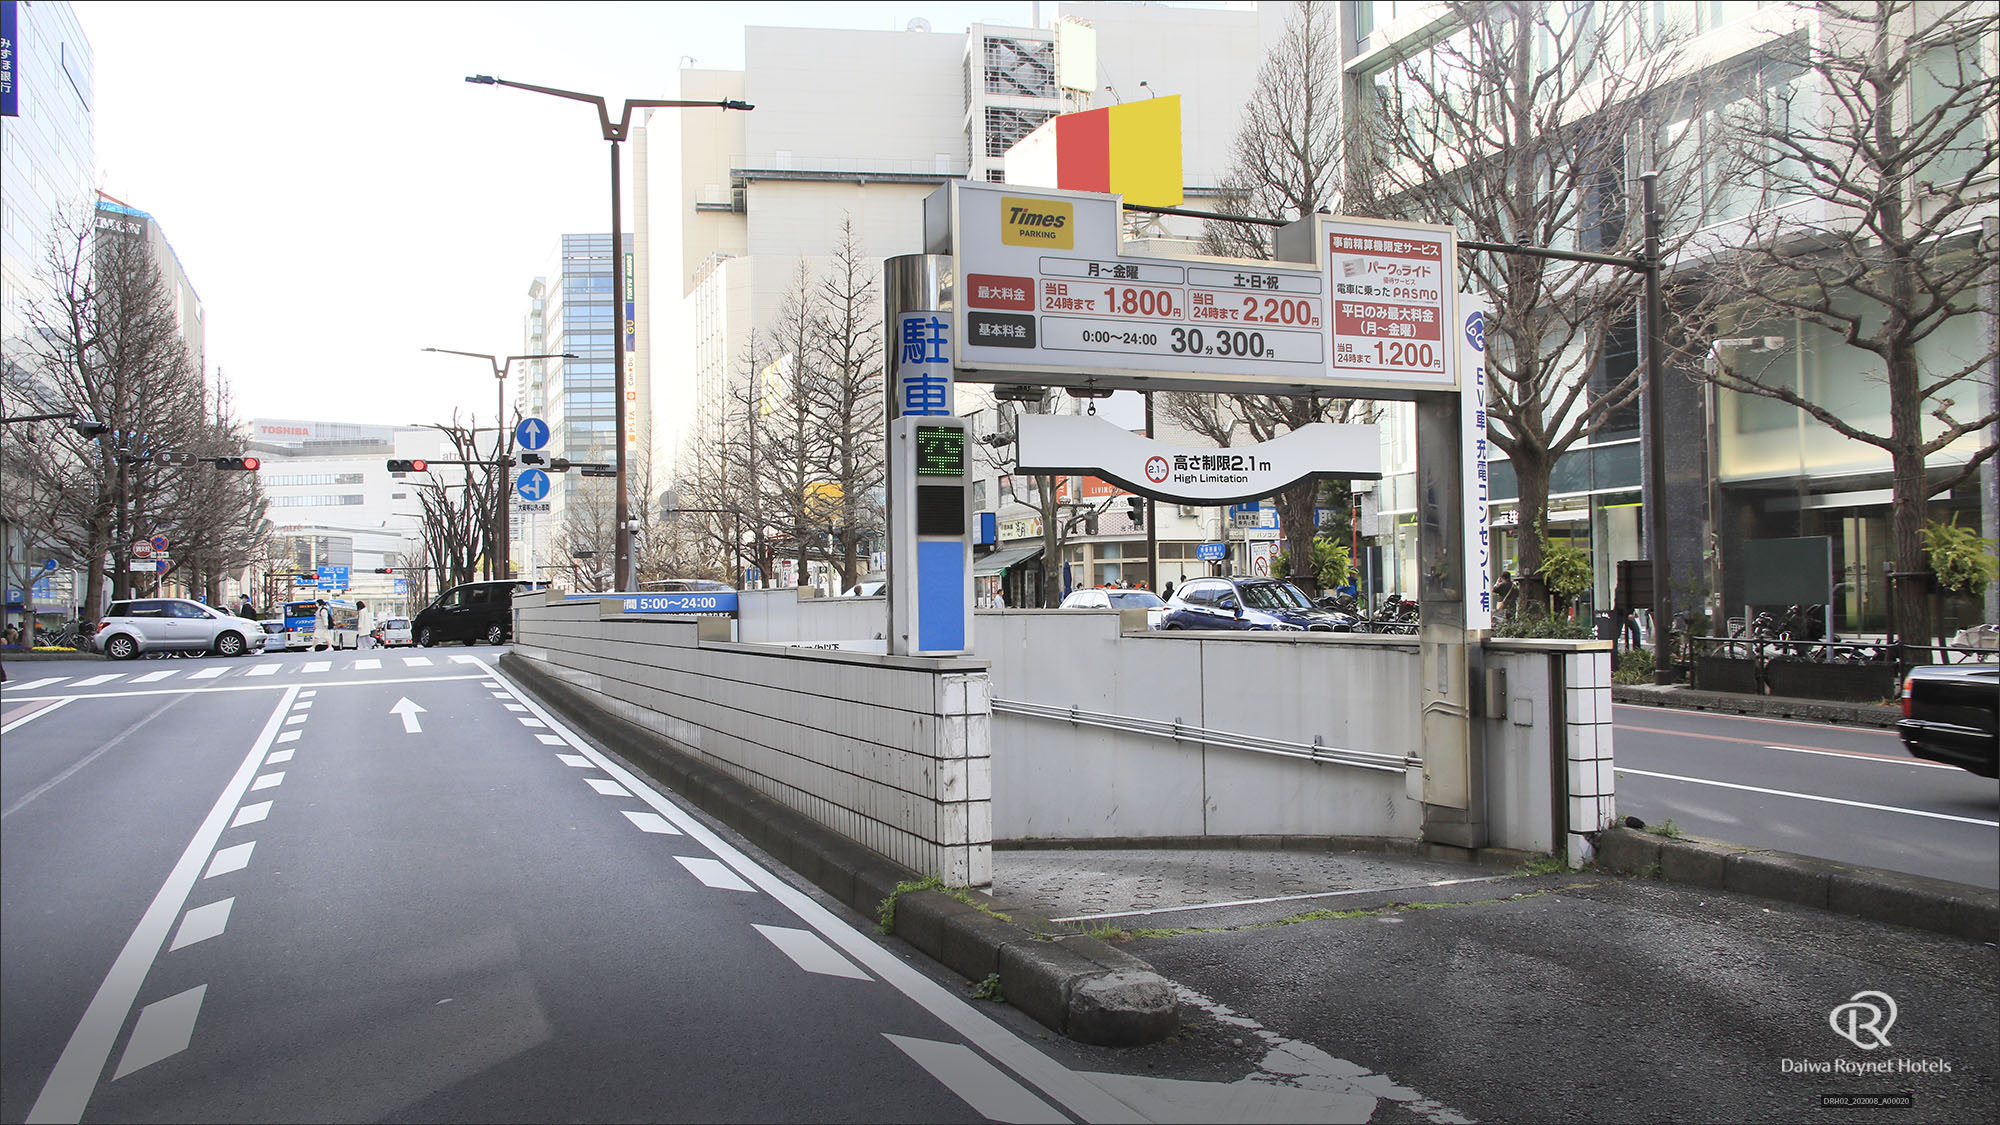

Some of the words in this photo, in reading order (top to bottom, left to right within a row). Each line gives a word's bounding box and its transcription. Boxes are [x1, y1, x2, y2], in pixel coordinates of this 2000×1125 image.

[1009, 206, 1066, 228] Times
[1019, 229, 1057, 239] PARKING
[1332, 236, 1440, 256] 事前精算機限定サービス
[977, 285, 1026, 302] 最大料金
[1045, 282, 1068, 296] 当日
[1336, 282, 1391, 298] 電車に乗った
[1392, 286, 1439, 301] PASMO
[1046, 296, 1096, 312] 24時まで
[1193, 292, 1214, 306] 当日
[1193, 306, 1240, 321] 24時まで
[1341, 303, 1435, 323] 平日のみ最大料金
[626, 319, 635, 335] GU
[978, 322, 1027, 339] 基本料金
[1337, 342, 1353, 353] 当日
[1337, 353, 1372, 364] 24時まで
[261, 425, 310, 436] TOSHIBA
[917, 426, 965, 475] 空
[1174, 474, 1198, 485] High
[1199, 474, 1249, 484] Limitation
